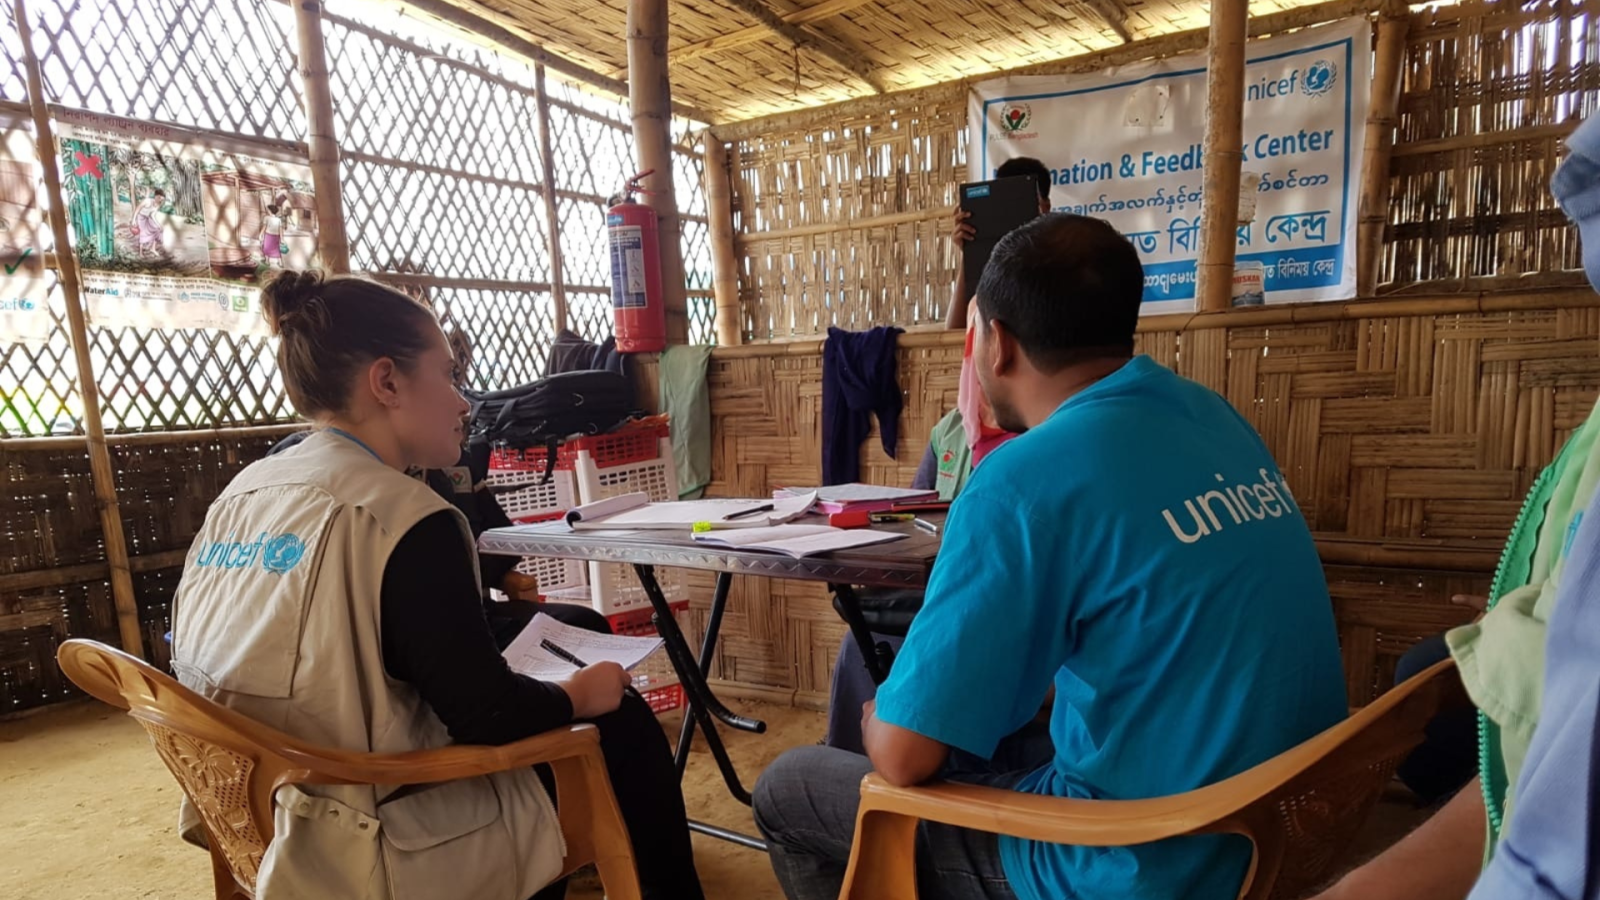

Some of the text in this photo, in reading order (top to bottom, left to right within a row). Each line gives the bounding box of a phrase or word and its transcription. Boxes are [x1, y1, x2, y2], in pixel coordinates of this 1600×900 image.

[1247, 69, 1299, 102] nicef
[1119, 154, 1136, 178] &
[1254, 129, 1334, 159] Center
[1265, 210, 1331, 243] কেন্দ্র
[1161, 468, 1292, 544] unicef
[196, 530, 268, 570] unicef
